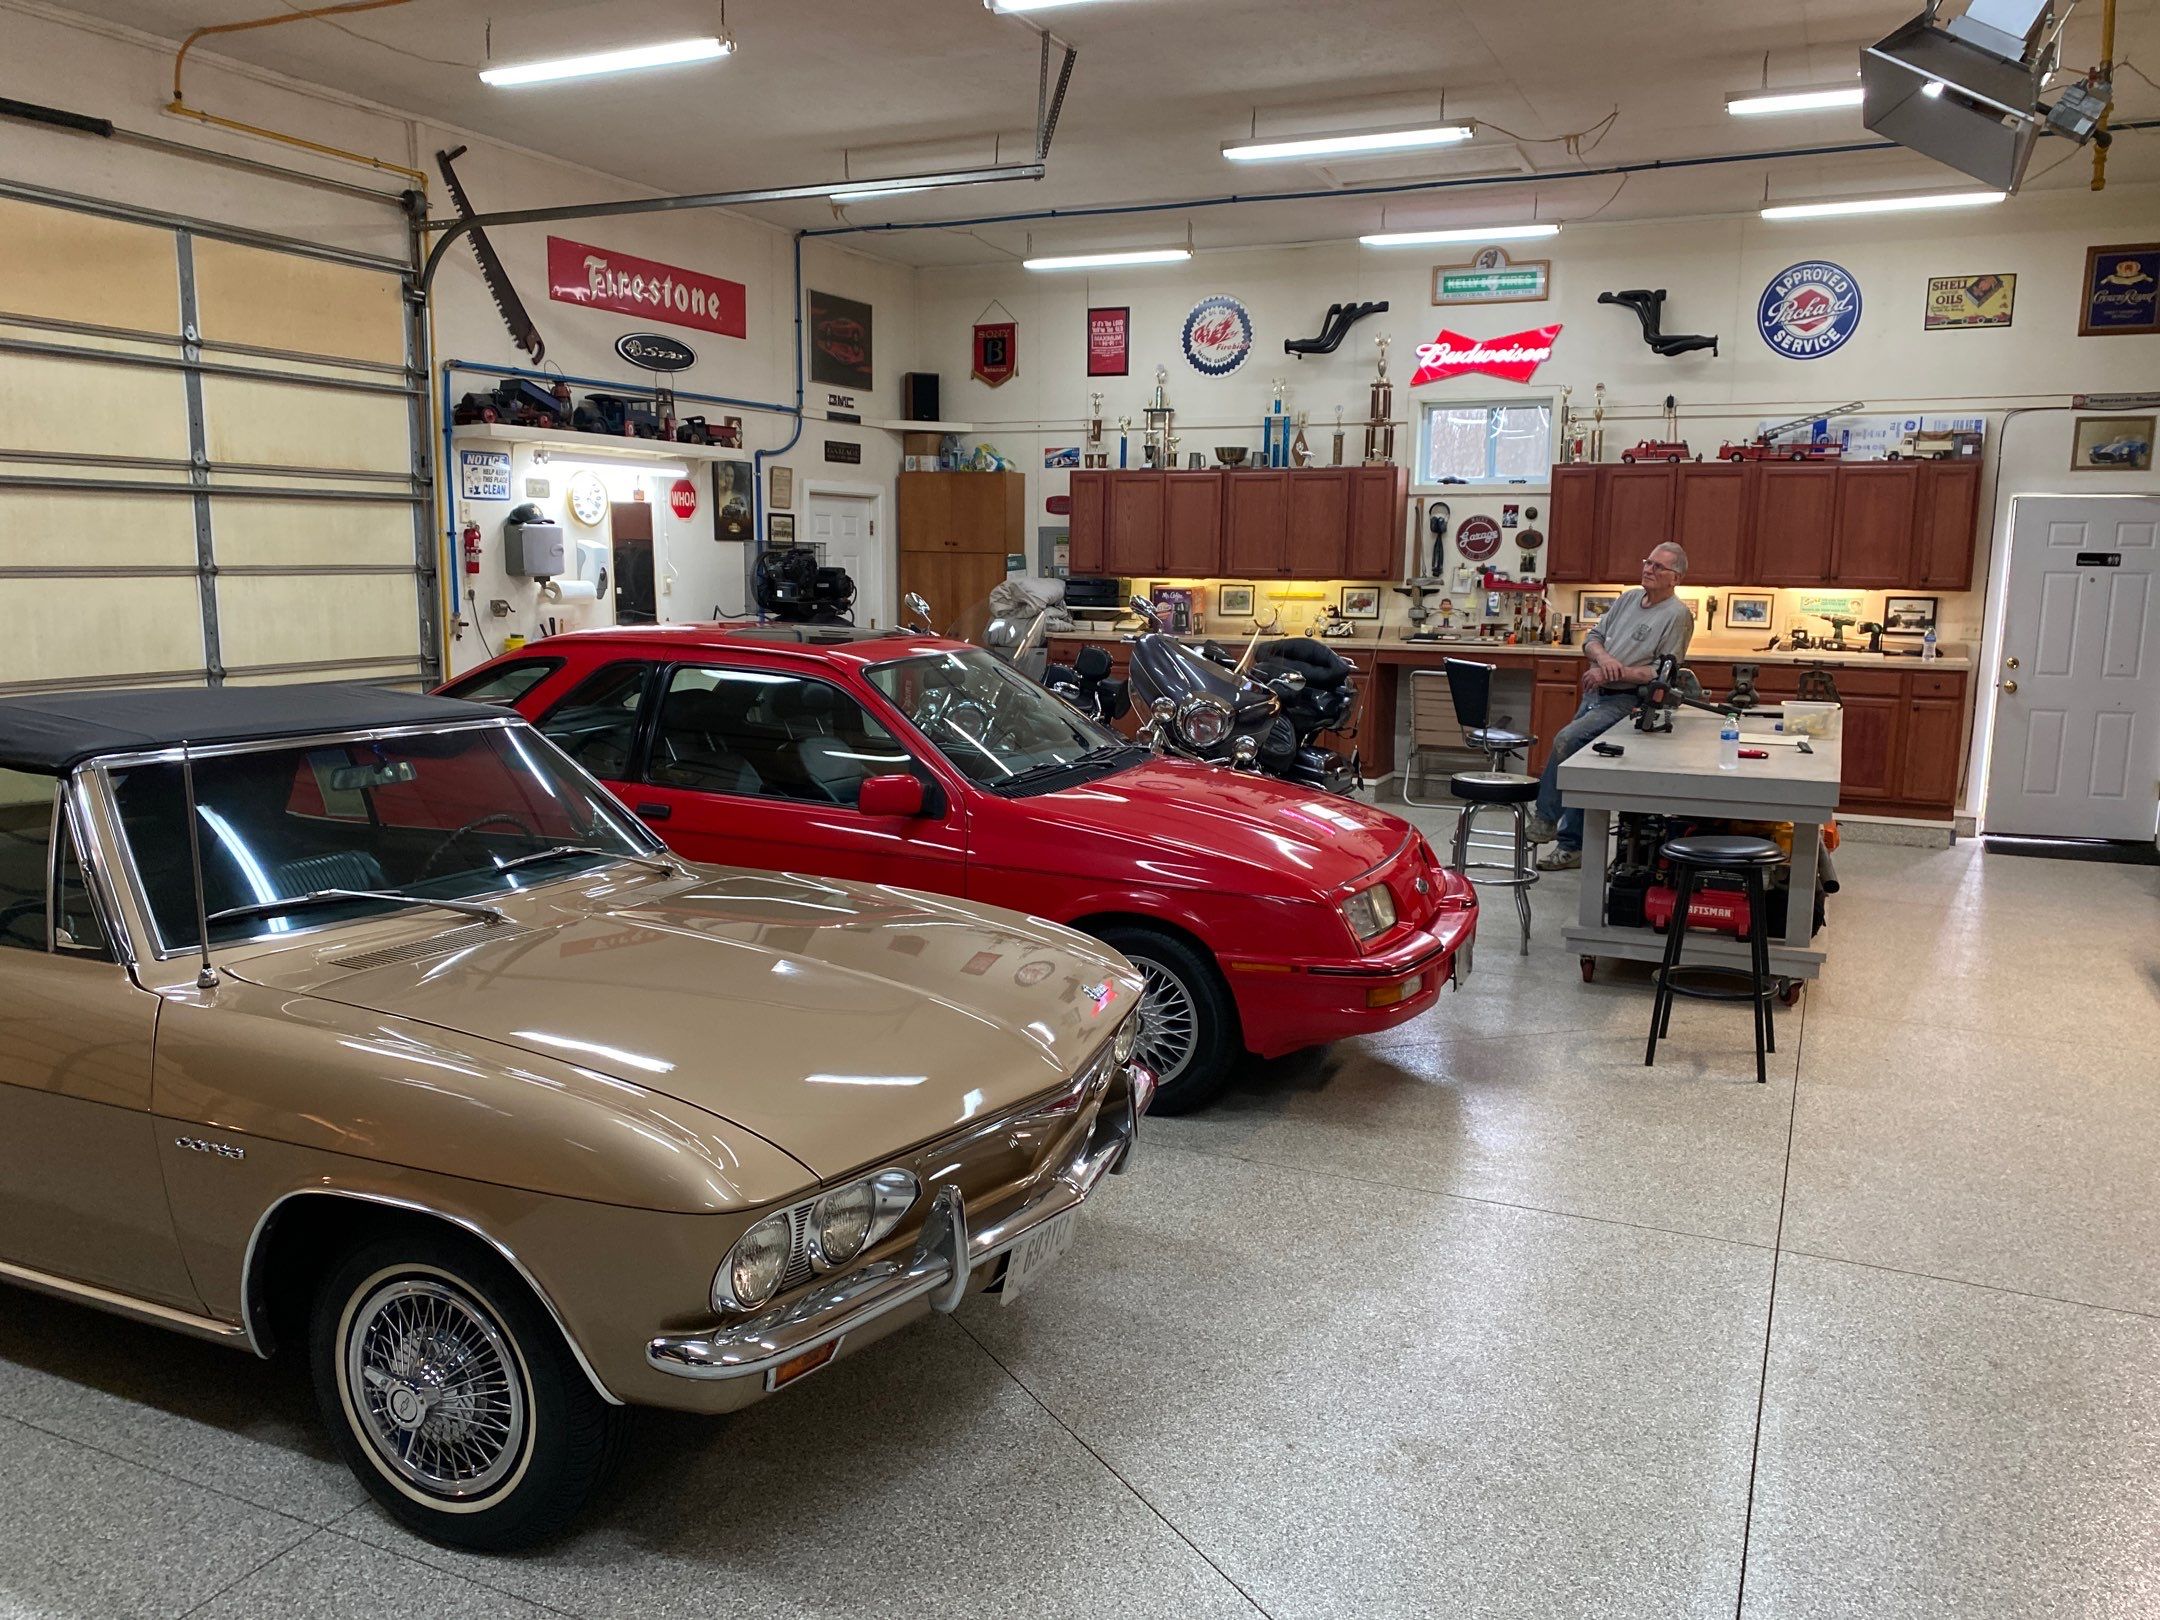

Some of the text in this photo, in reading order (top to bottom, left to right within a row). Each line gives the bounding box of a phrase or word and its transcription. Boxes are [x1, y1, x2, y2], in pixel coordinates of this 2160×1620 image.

[1501, 274, 1532, 286] TIRES
[1775, 268, 1848, 297] APPROVED
[1932, 280, 1968, 291] SHELL
[584, 255, 721, 320] Firestone
[1936, 295, 1963, 304] OILS
[1764, 292, 1853, 327] Packard
[978, 330, 1009, 339] SONY
[1773, 327, 1841, 353] SERVICE
[1216, 342, 1250, 350] Firebird
[1415, 342, 1551, 368] Budweiser
[467, 454, 506, 466] NOTICE
[483, 485, 506, 495] CLEAN
[671, 491, 696, 507] WHOA
[1460, 530, 1499, 548] Garage
[1688, 905, 1731, 917] AFTSMAN
